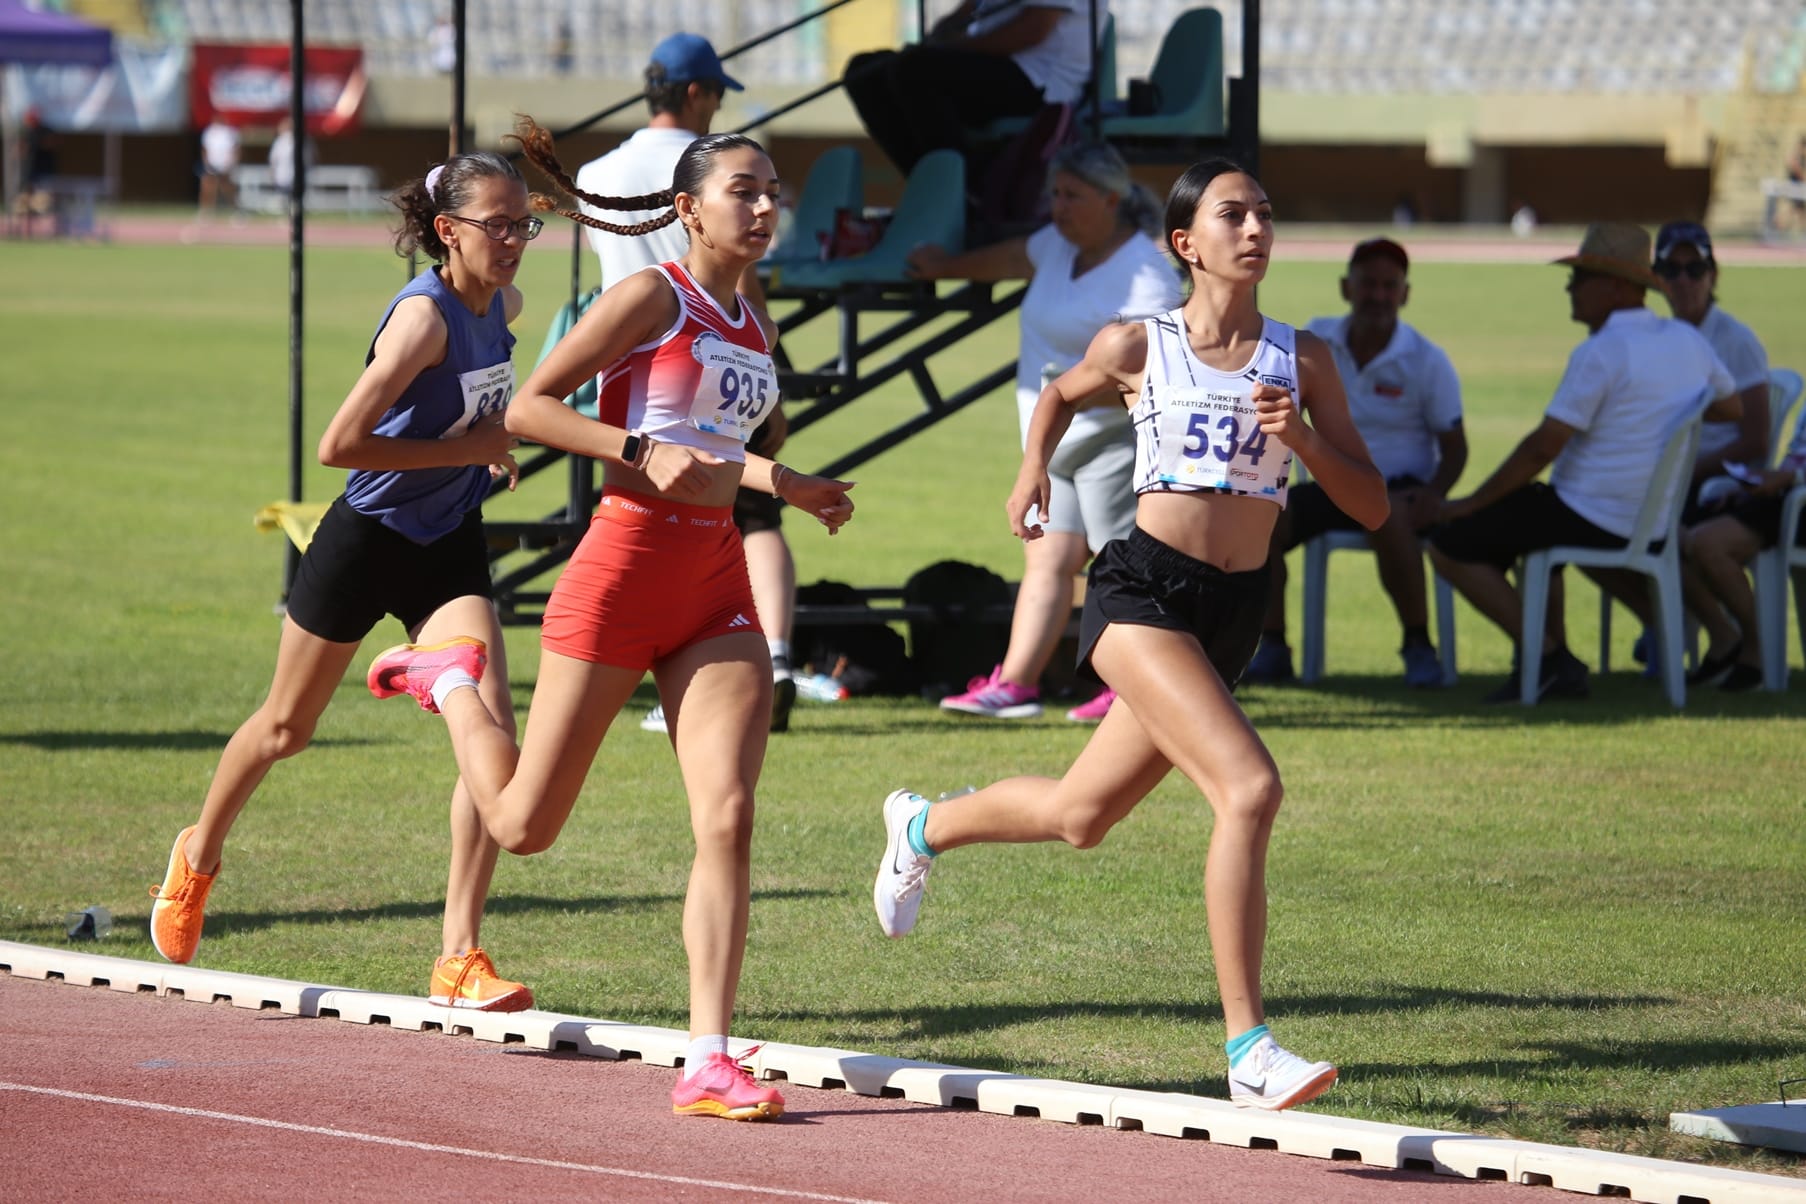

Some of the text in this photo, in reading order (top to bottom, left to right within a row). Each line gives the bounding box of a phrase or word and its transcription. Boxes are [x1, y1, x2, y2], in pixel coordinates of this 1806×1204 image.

[1264, 377, 1288, 388] ENKA
[717, 367, 768, 419] 935
[1207, 393, 1241, 404] TÜRKİYE
[1170, 399, 1257, 415] ATLETİZM FEDERASY
[1183, 413, 1267, 466] 534
[620, 501, 653, 516] TECHFIT
[690, 518, 718, 527] TECHFIT
